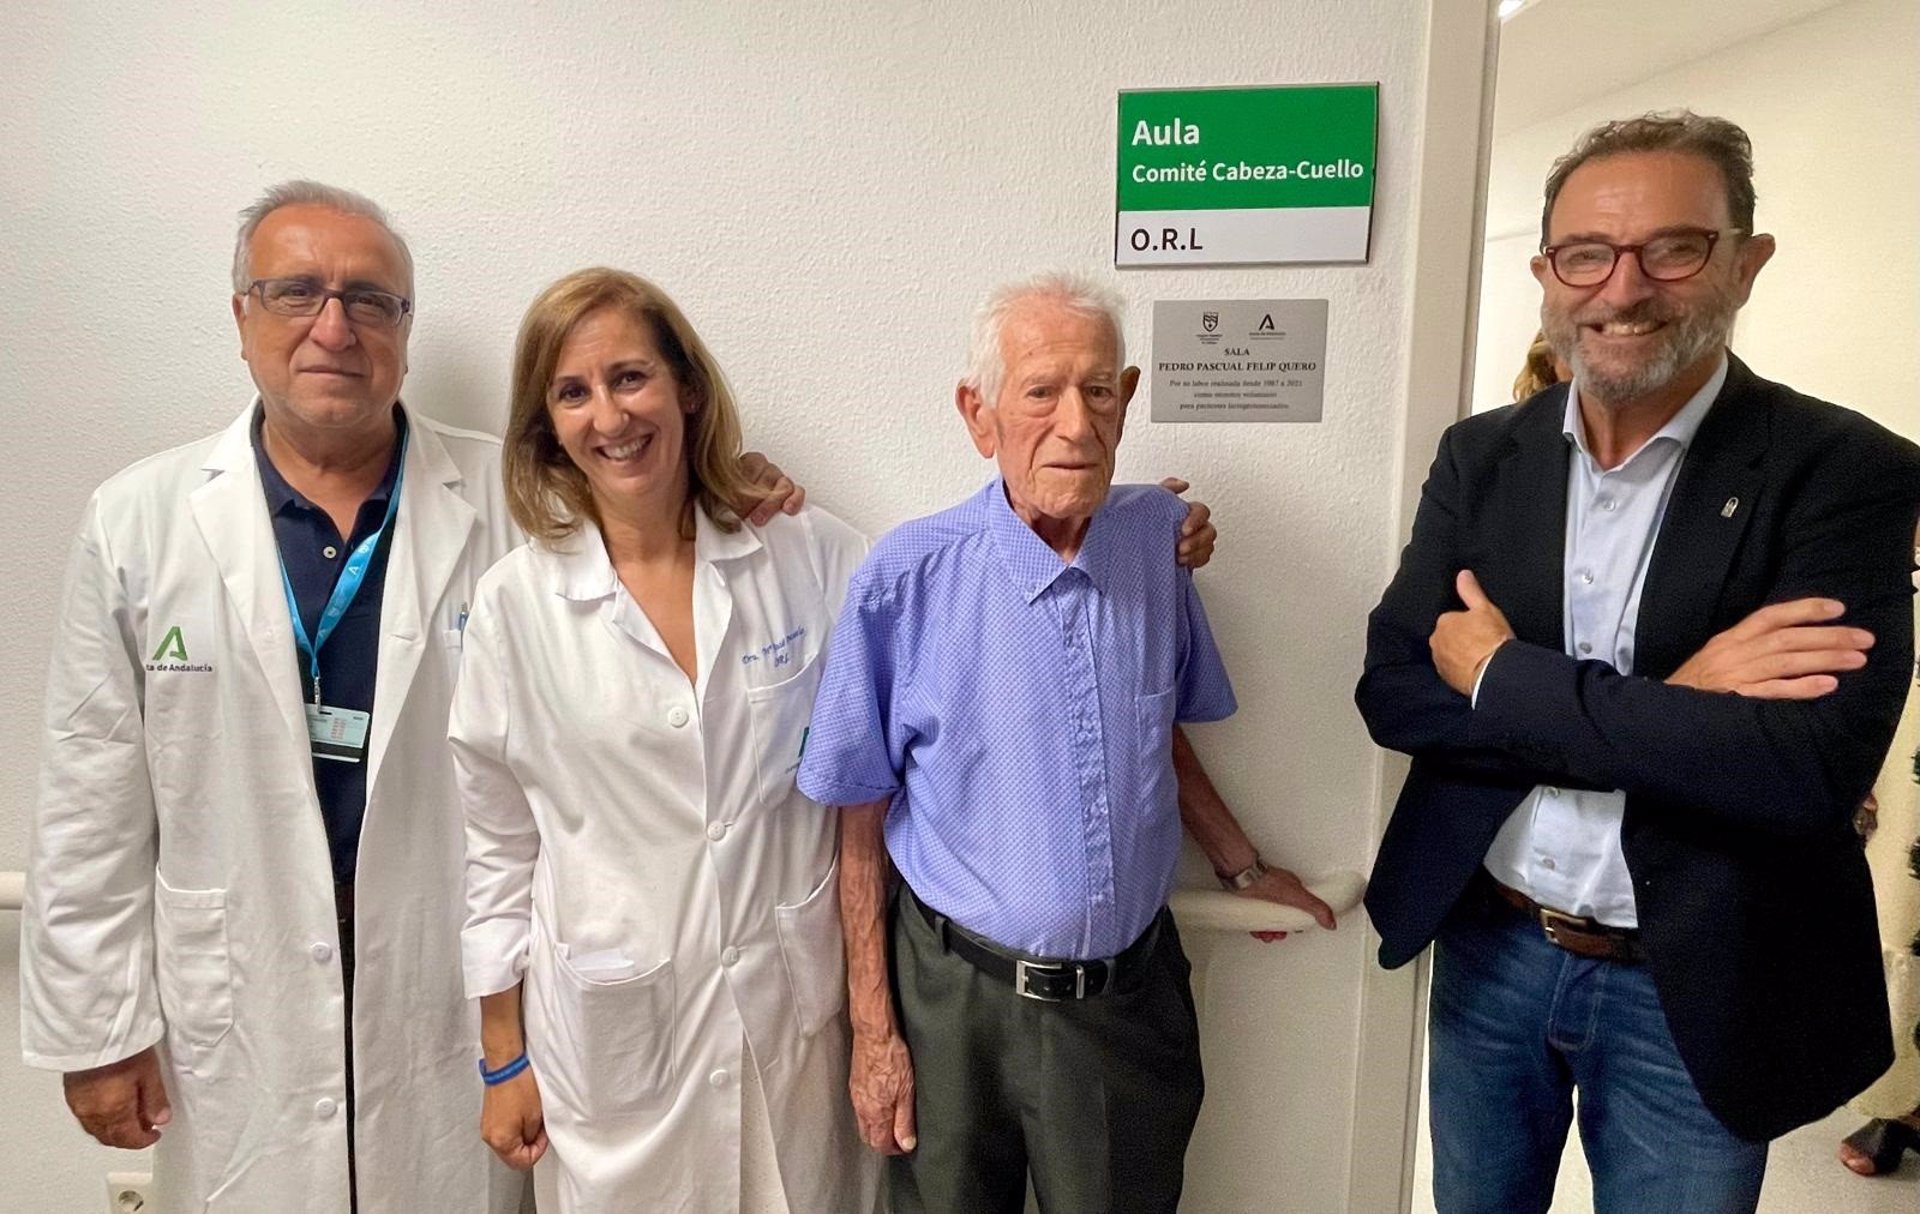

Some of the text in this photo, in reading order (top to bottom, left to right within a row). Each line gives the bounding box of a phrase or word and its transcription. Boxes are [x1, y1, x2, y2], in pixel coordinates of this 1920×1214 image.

[1132, 118, 1200, 146] Aula
[1132, 159, 1364, 183] Comité Cabeza-Cuello
[1131, 228, 1203, 251] O.R.L
[1224, 348, 1250, 356] SALA
[1158, 362, 1317, 373] PEDRO PASCUAL FELIP QUERO
[169, 663, 212, 672] Andalucía
